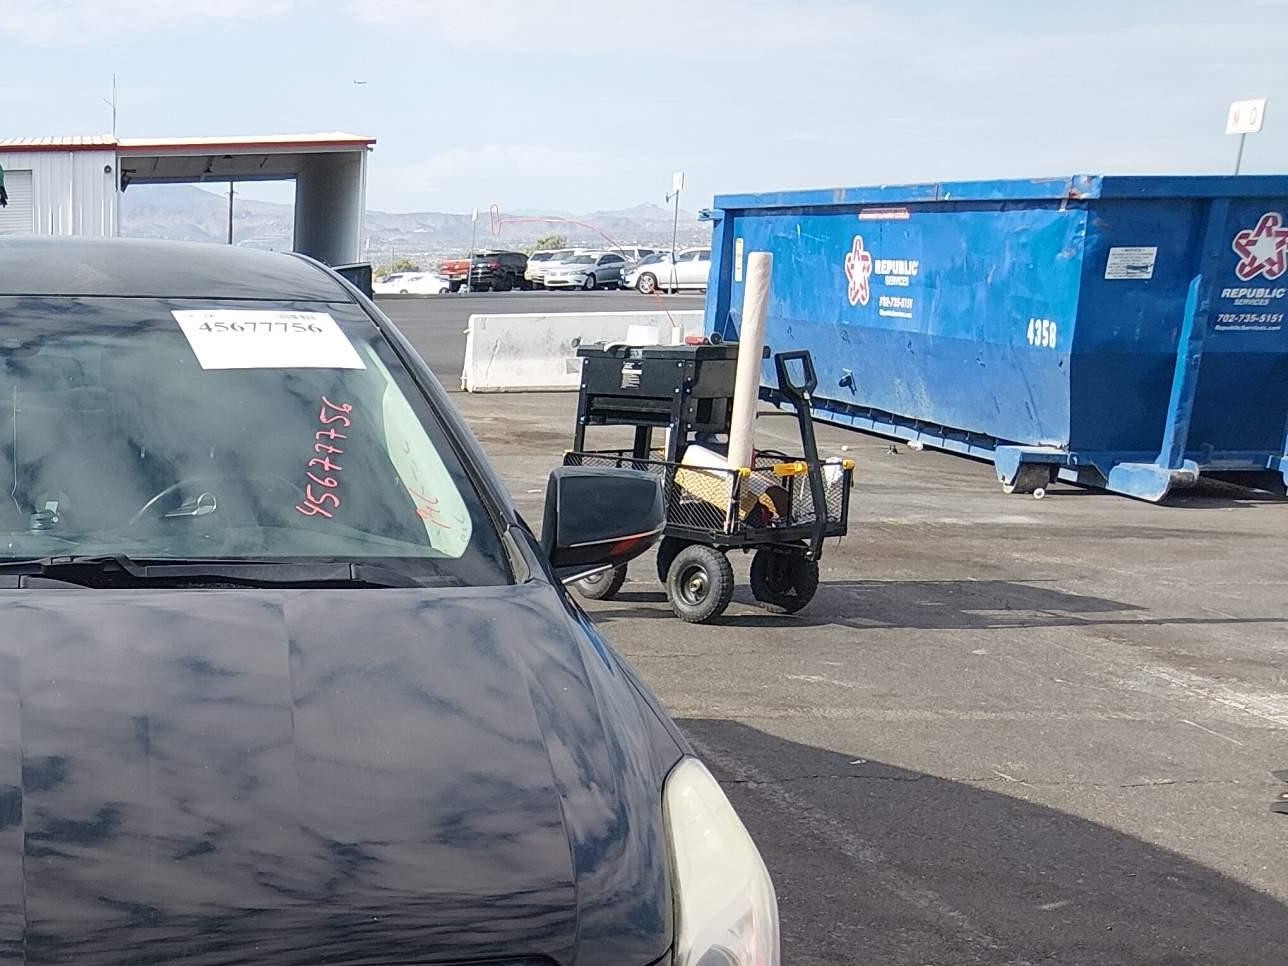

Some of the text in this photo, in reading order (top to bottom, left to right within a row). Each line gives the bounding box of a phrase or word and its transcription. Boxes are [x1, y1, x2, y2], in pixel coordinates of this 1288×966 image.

[874, 259, 920, 276] REPUBLIC
[1220, 287, 1287, 299] REPUBLIC
[1216, 313, 1284, 323] 702-735-5151
[199, 321, 323, 334] 45677756
[1026, 317, 1057, 349] 4358
[295, 395, 353, 518] 45677756
